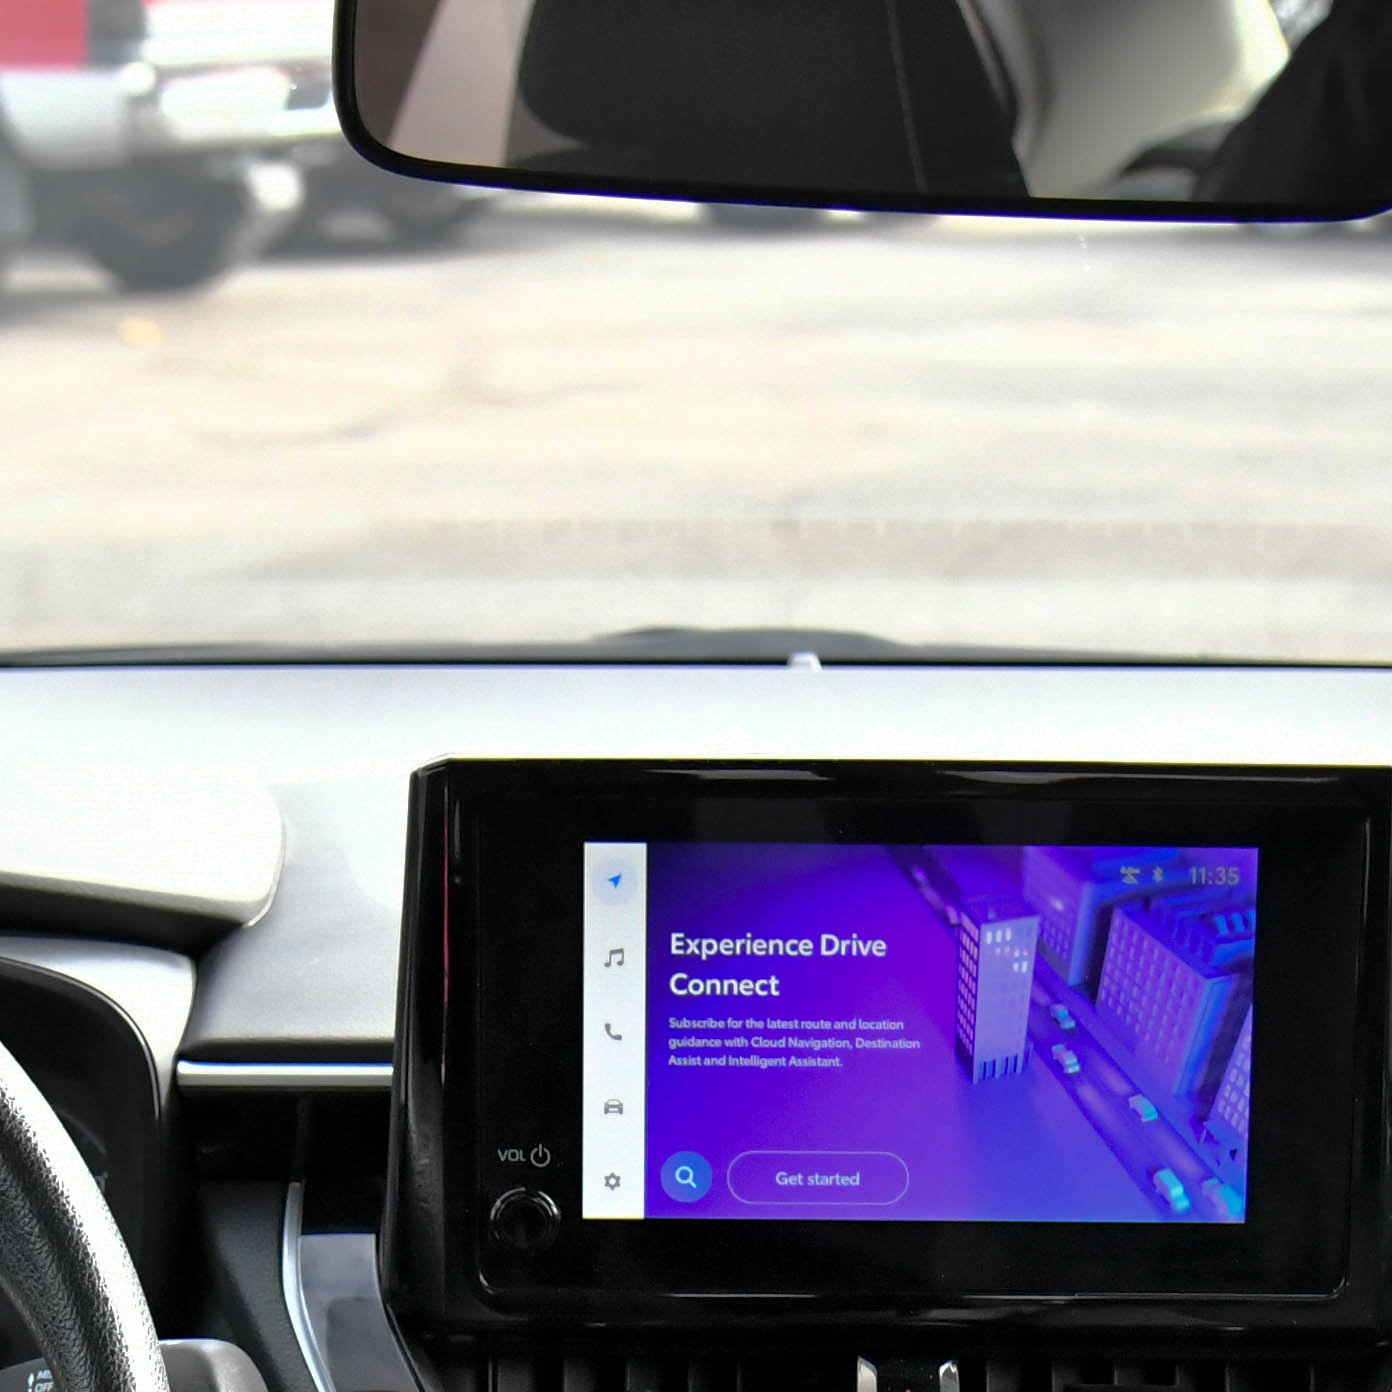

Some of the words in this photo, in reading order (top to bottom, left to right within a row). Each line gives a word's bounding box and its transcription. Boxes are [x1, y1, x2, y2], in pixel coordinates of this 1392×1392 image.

[1189, 866, 1240, 885] 11:35
[670, 932, 814, 960] Experience
[819, 933, 888, 957] Drive
[669, 973, 780, 997] Connect
[668, 1016, 726, 1030] Subscribe
[727, 1017, 743, 1030] for
[745, 1017, 765, 1030] the
[767, 1017, 799, 1030] latest
[800, 1019, 832, 1031] route
[833, 1018, 857, 1031] and
[858, 1018, 905, 1031] location
[668, 1036, 722, 1050] guidance
[724, 1036, 749, 1048] with
[751, 1036, 786, 1049] Cloud
[788, 1037, 853, 1051] Navigation,
[855, 1038, 920, 1050] Destination
[668, 1055, 702, 1067] Assist
[703, 1055, 727, 1067] and
[728, 1055, 786, 1069] Intelligent
[788, 1056, 844, 1068] Assistant.
[497, 1148, 527, 1162] VOL
[775, 1171, 803, 1186] Get
[807, 1171, 861, 1187] started
